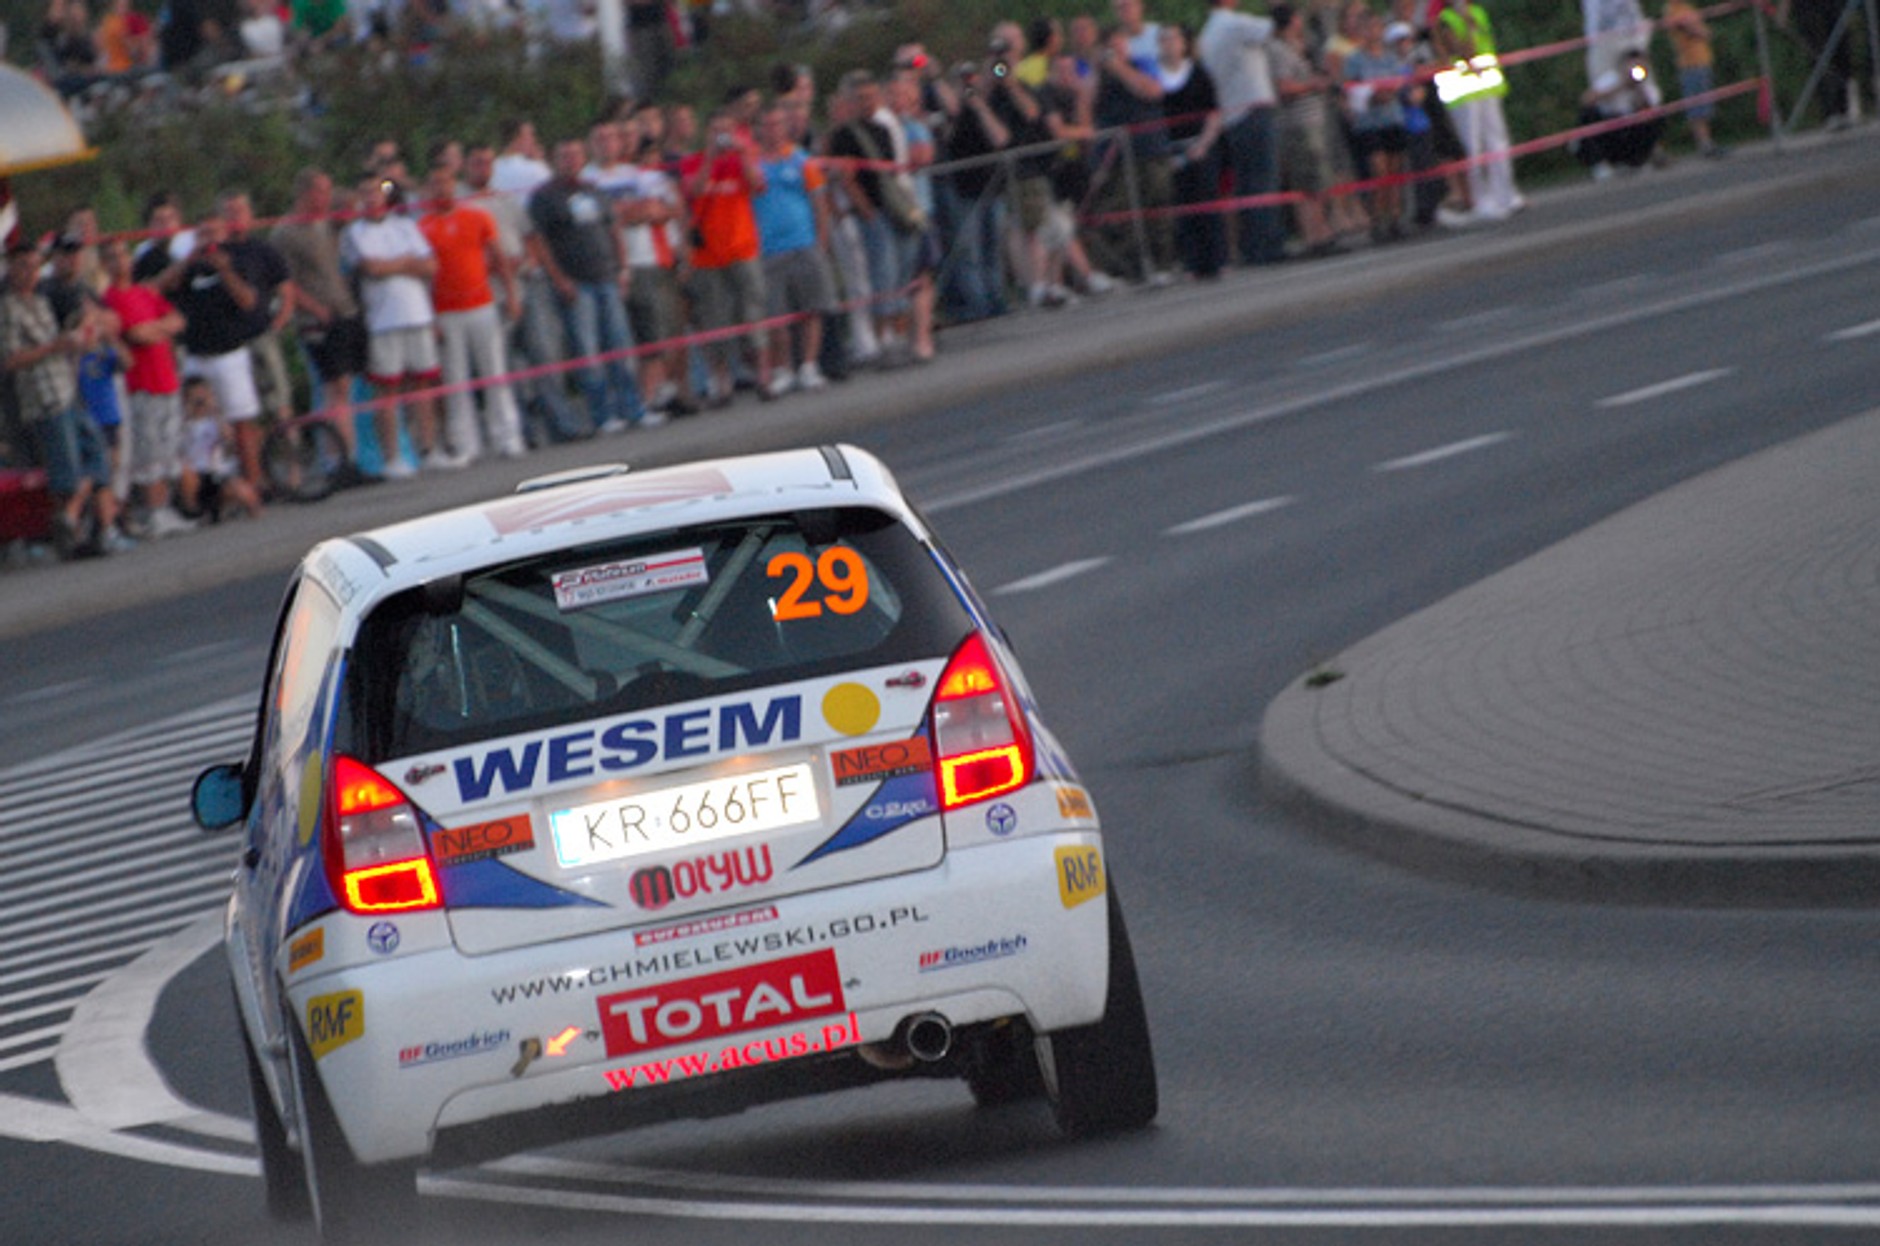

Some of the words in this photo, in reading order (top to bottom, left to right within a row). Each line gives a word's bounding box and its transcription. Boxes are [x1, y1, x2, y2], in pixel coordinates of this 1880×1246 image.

[765, 545, 870, 622] 29
[454, 695, 802, 804] WESEM
[837, 742, 910, 772] NEO
[442, 822, 514, 855] NEO
[584, 804, 649, 851] KR
[668, 773, 800, 834] 666FF
[308, 997, 355, 1043] RMF
[602, 1010, 864, 1093] www.acus.pl
